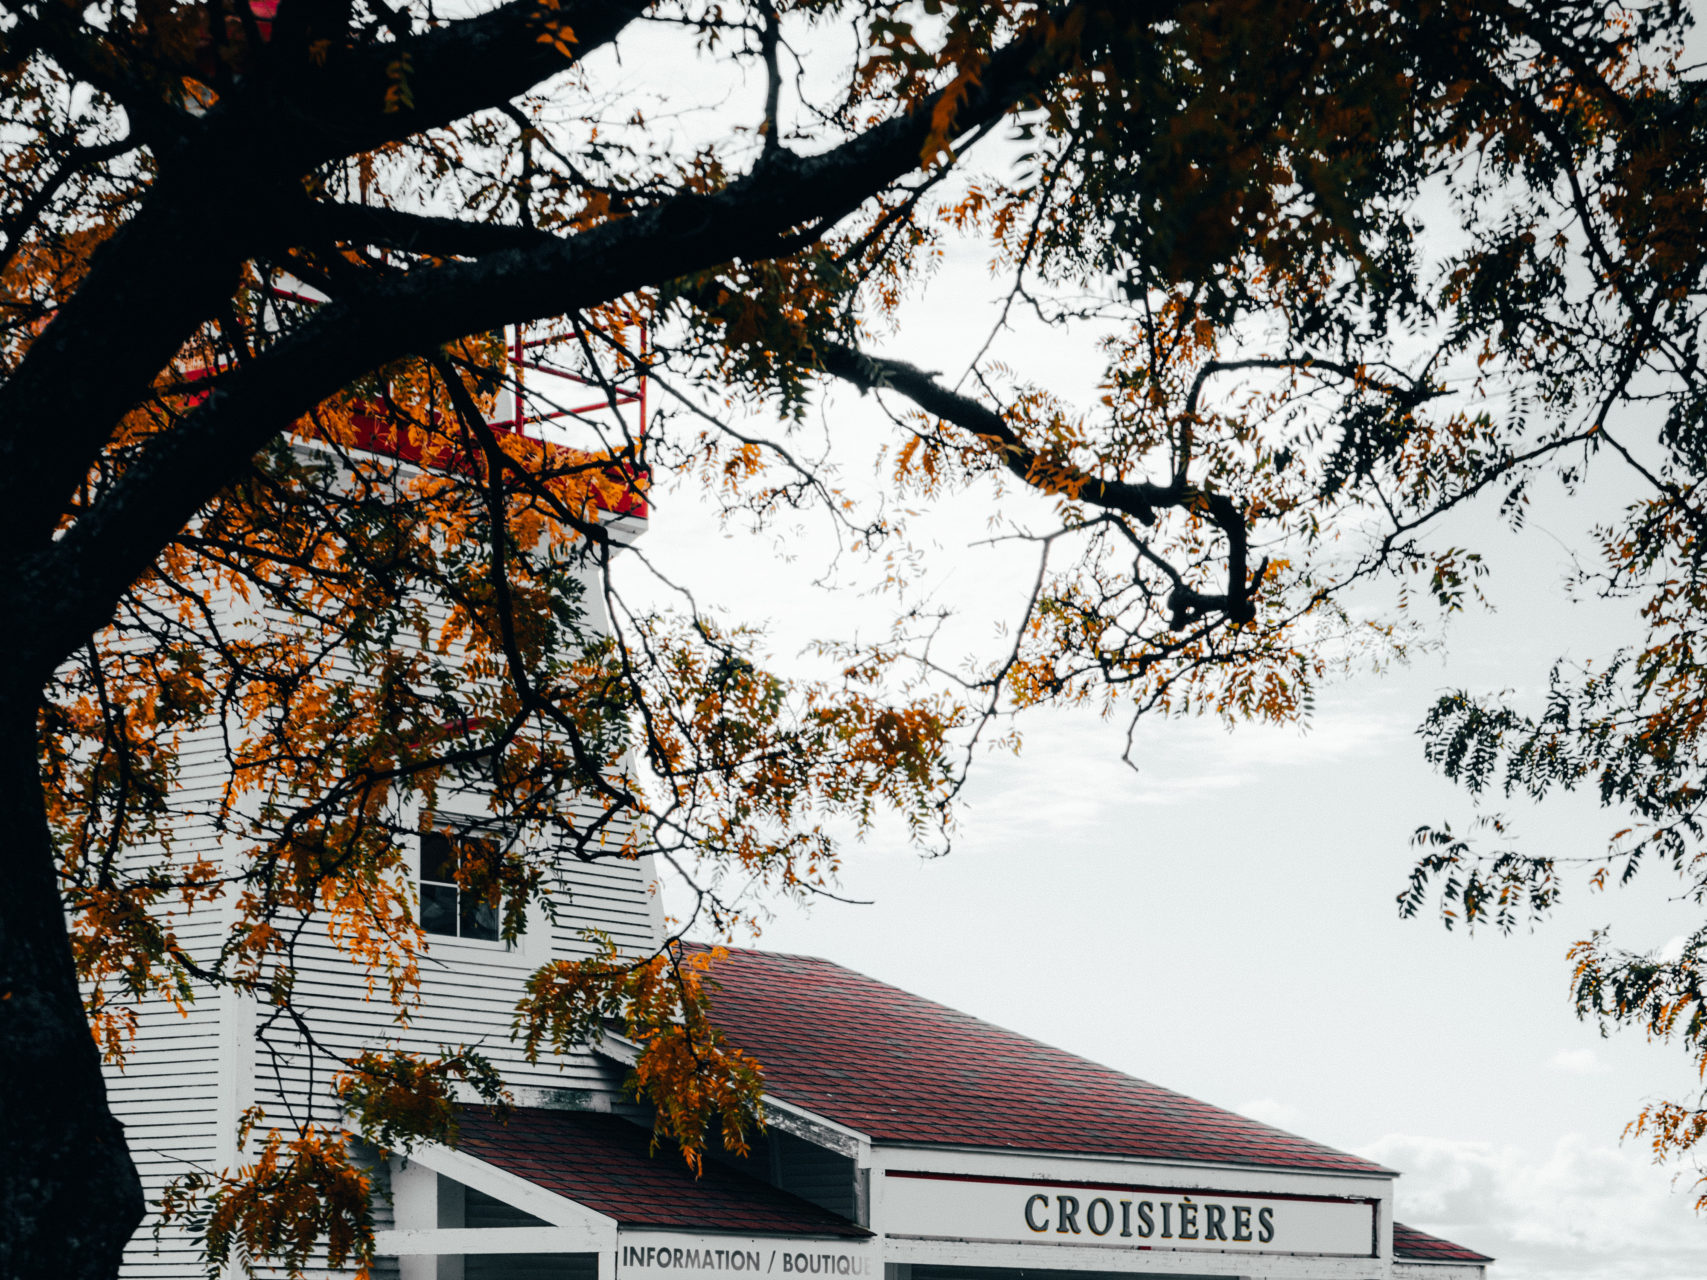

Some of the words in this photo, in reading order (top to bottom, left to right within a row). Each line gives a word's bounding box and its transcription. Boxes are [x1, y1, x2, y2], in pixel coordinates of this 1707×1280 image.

[1024, 1194, 1275, 1243] CROISIÈRES
[623, 1246, 760, 1271] INFORMATION
[767, 1250, 776, 1274] /
[783, 1253, 871, 1275] BOUTIQUE
